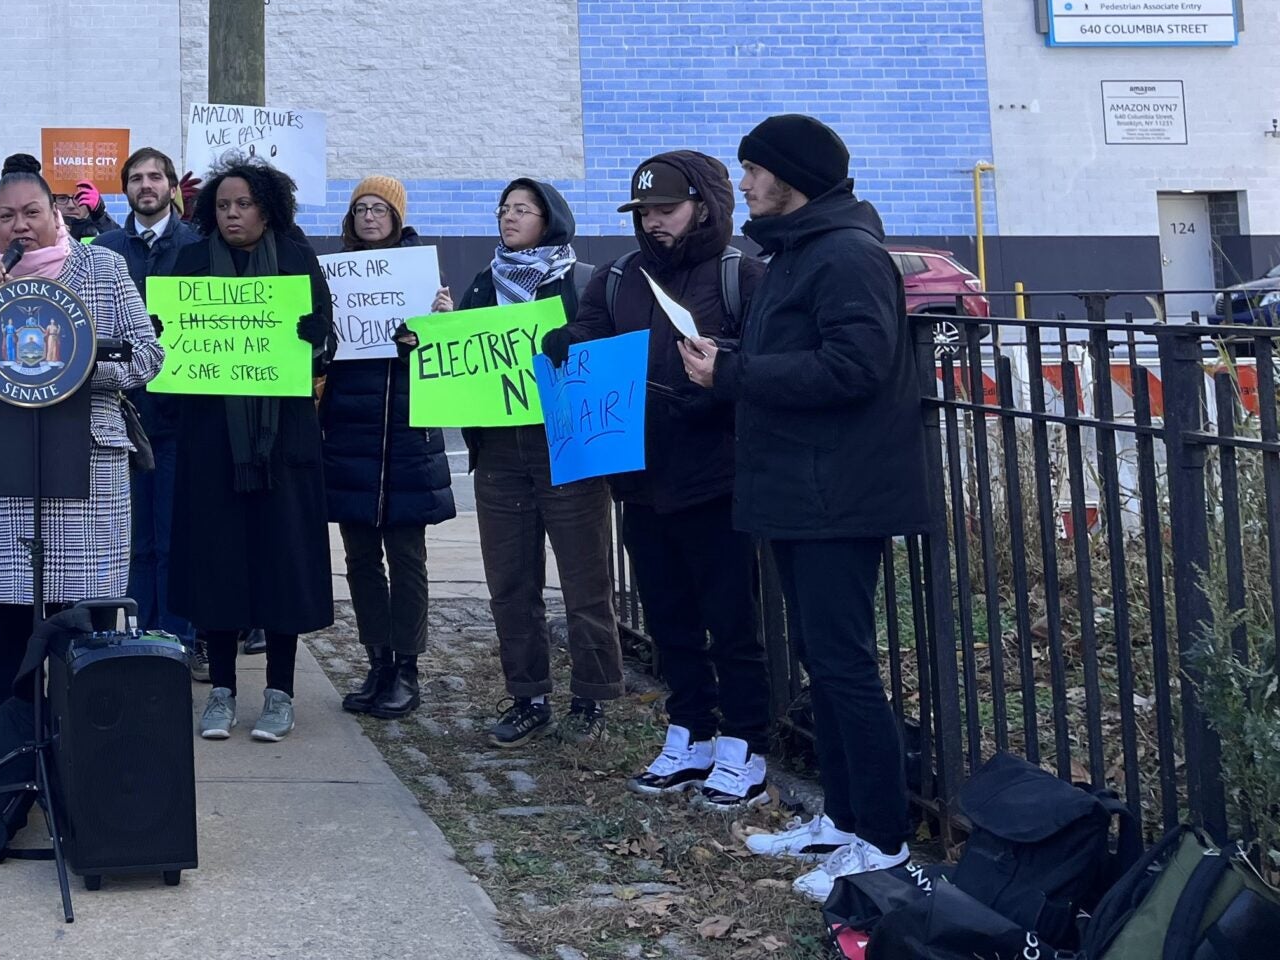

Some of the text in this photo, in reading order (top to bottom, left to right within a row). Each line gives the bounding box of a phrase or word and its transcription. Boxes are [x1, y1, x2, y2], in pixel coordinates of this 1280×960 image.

[1143, 2, 1179, 10] Associate
[1181, 2, 1202, 11] Entry
[1080, 24, 1208, 34] 640 COLUMBIA STREET
[191, 104, 244, 125] AMAZON
[1109, 103, 1151, 112] AMAZON
[205, 127, 231, 145] WE
[53, 156, 118, 166] LIVABLE CITY
[1170, 222, 1196, 235] 124
[366, 259, 393, 278] AIR
[178, 280, 273, 305] DELIVER:
[346, 291, 406, 309] STREETS
[6, 282, 51, 298] YORK
[51, 289, 87, 329] STATE
[179, 310, 280, 331] EMISSIONS
[182, 336, 271, 355] CLEAN AIR
[417, 323, 538, 380] ELECTRIFY
[187, 362, 280, 382] SAFE STREETS
[2, 382, 60, 401] SENATE
